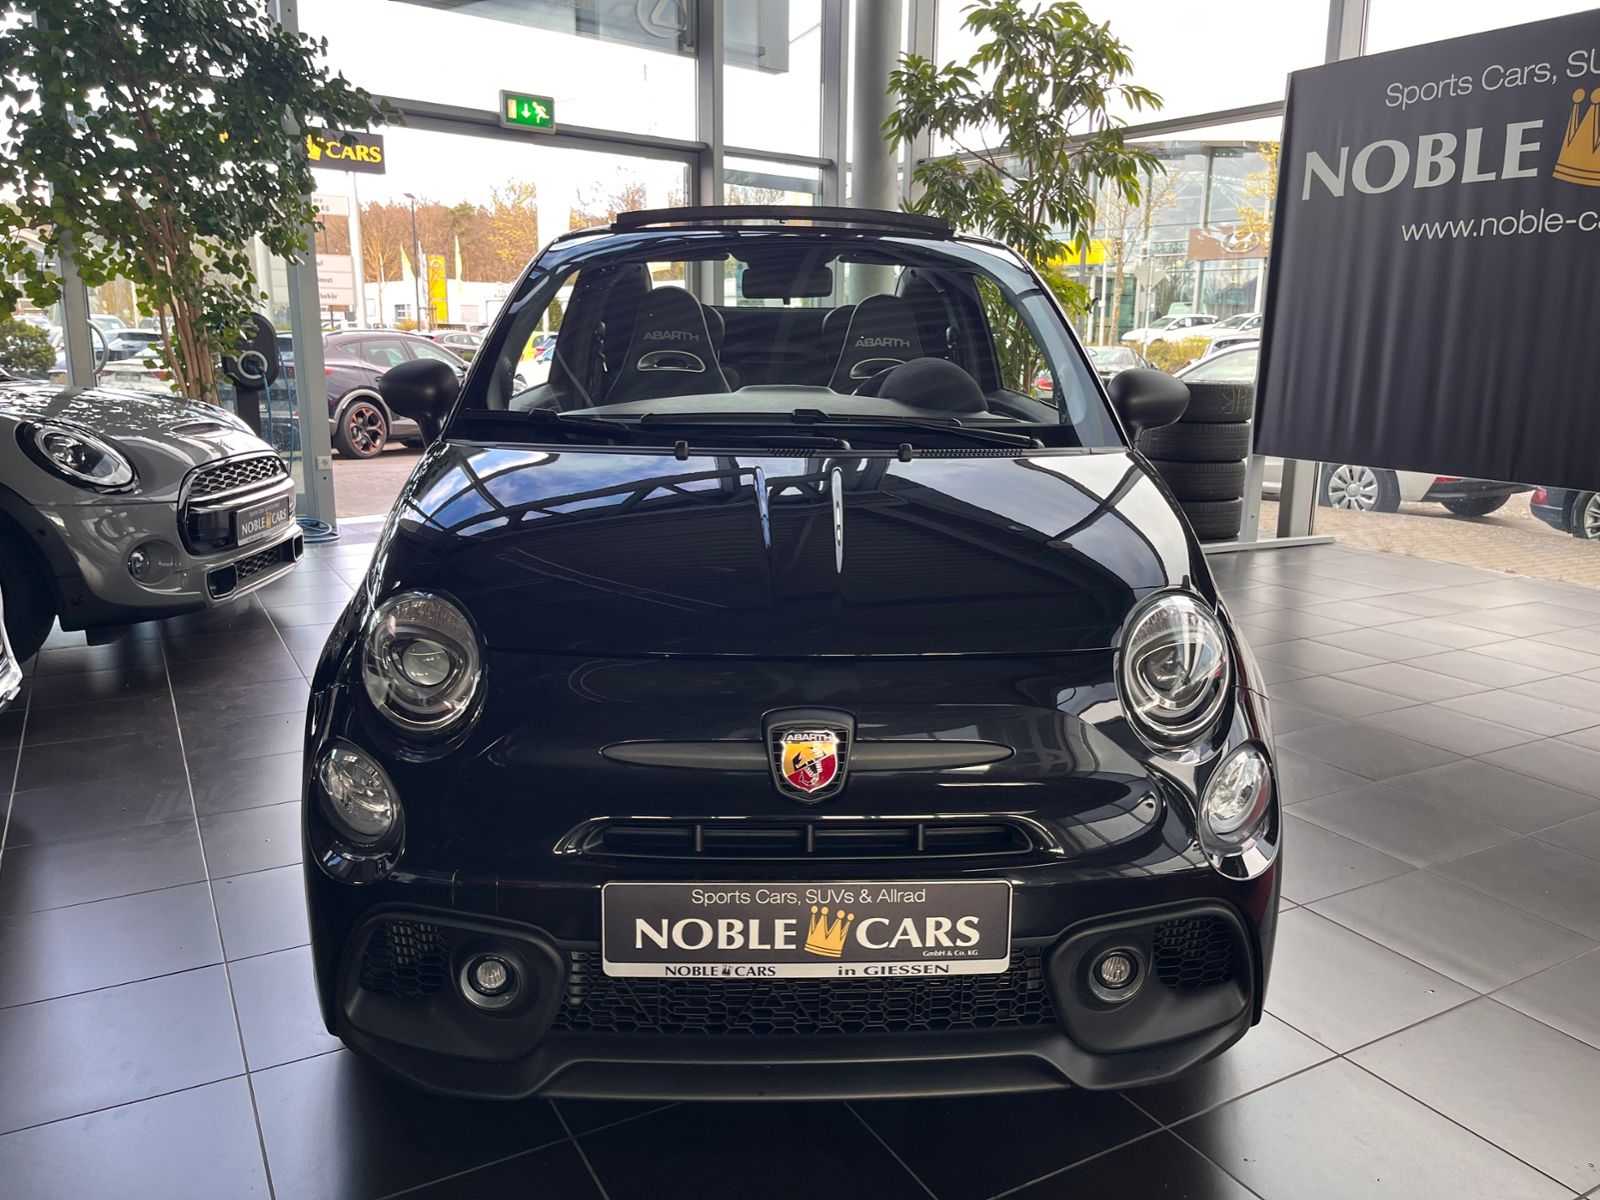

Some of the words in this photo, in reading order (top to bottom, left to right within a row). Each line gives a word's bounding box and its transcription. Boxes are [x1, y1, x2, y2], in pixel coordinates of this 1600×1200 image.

[1385, 75, 1473, 111] Sports
[1481, 62, 1557, 91] Cars,
[325, 141, 383, 163] CARS
[1302, 119, 1545, 200] NOBLE
[1401, 208, 1600, 241] www.noble-c
[643, 330, 699, 342] ABARTH
[855, 336, 910, 348] ABARTH
[241, 516, 266, 536] NOBLE
[271, 508, 287, 524] CARS
[786, 733, 834, 741] ABARTH
[692, 889, 751, 907] Sports
[756, 889, 801, 905] Cars,
[805, 889, 854, 904] SUVs
[859, 889, 873, 903] &
[876, 888, 926, 903] Allrad
[635, 918, 797, 950] NOBLE
[856, 916, 980, 949] CARS
[665, 966, 718, 976] NOBLE
[734, 966, 776, 976] CARS
[838, 966, 856, 976] in
[863, 965, 949, 976] GIESSEN
